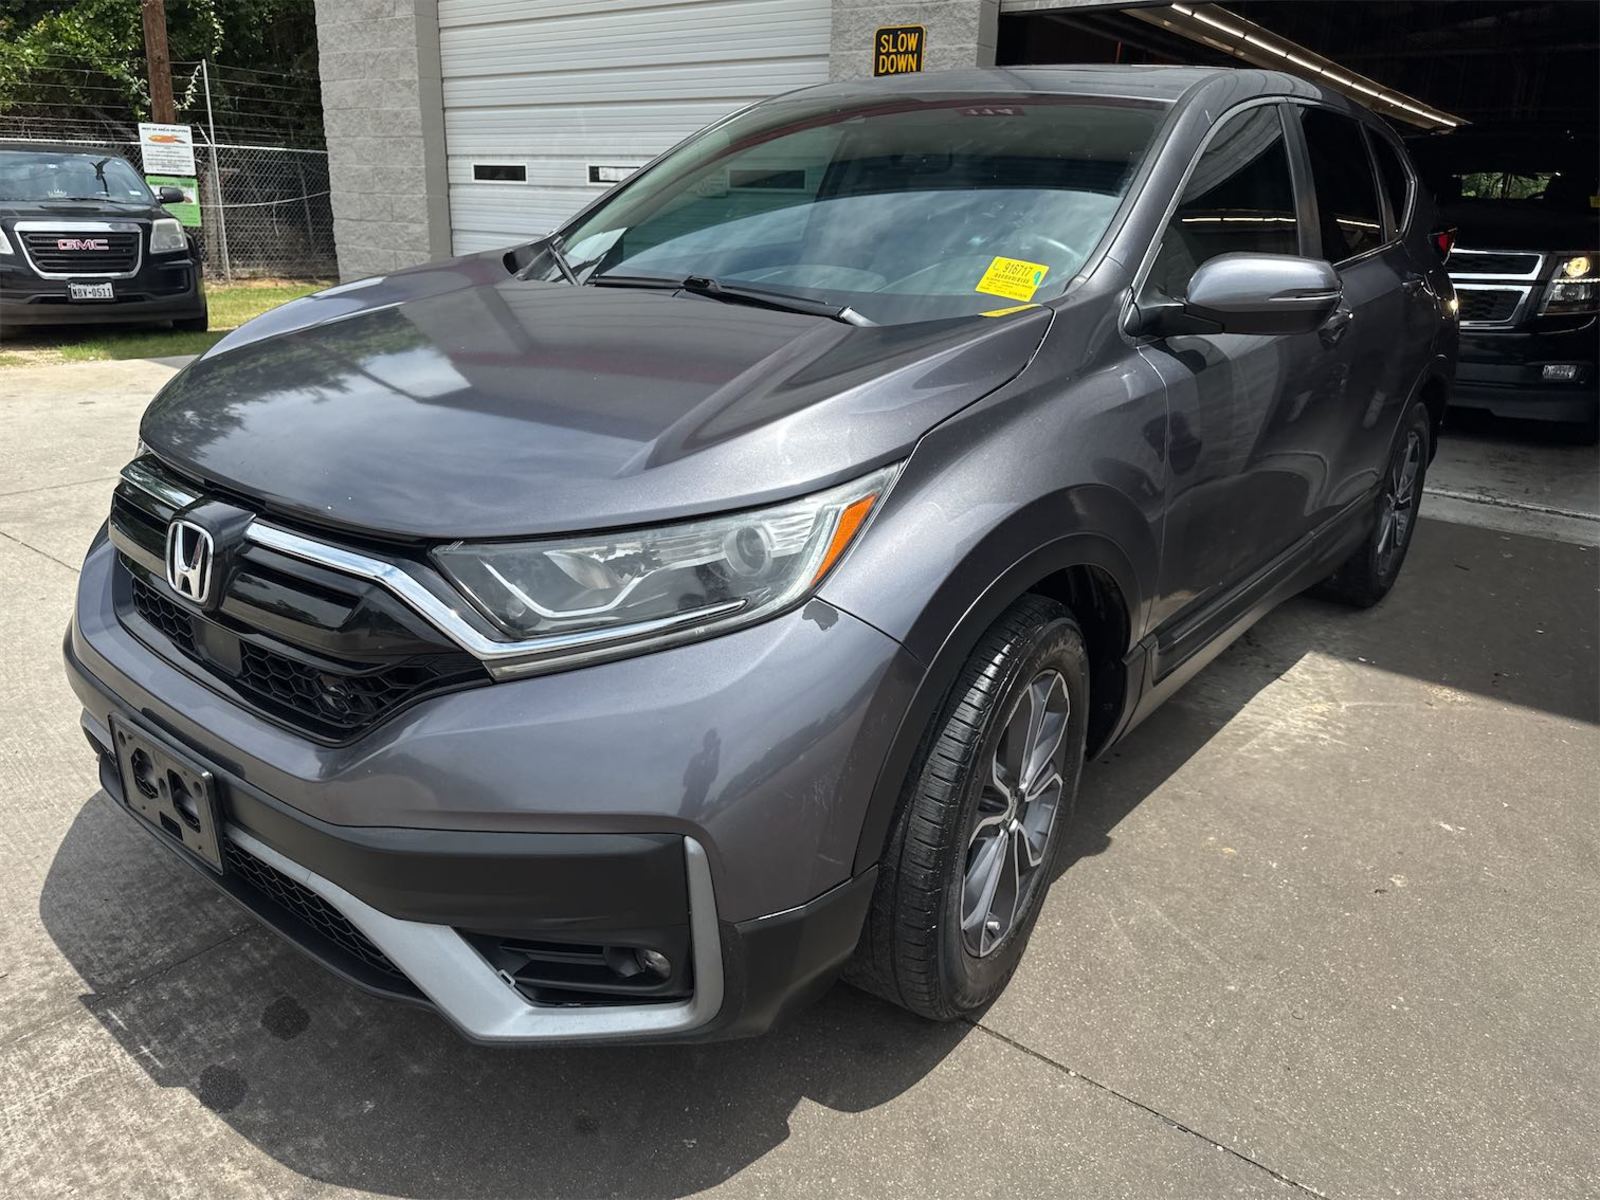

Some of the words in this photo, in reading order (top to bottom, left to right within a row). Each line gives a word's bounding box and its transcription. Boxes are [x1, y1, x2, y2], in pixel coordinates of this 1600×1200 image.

[880, 32, 919, 53] SLOW
[879, 53, 917, 74] DOWN
[57, 239, 110, 250] GMC
